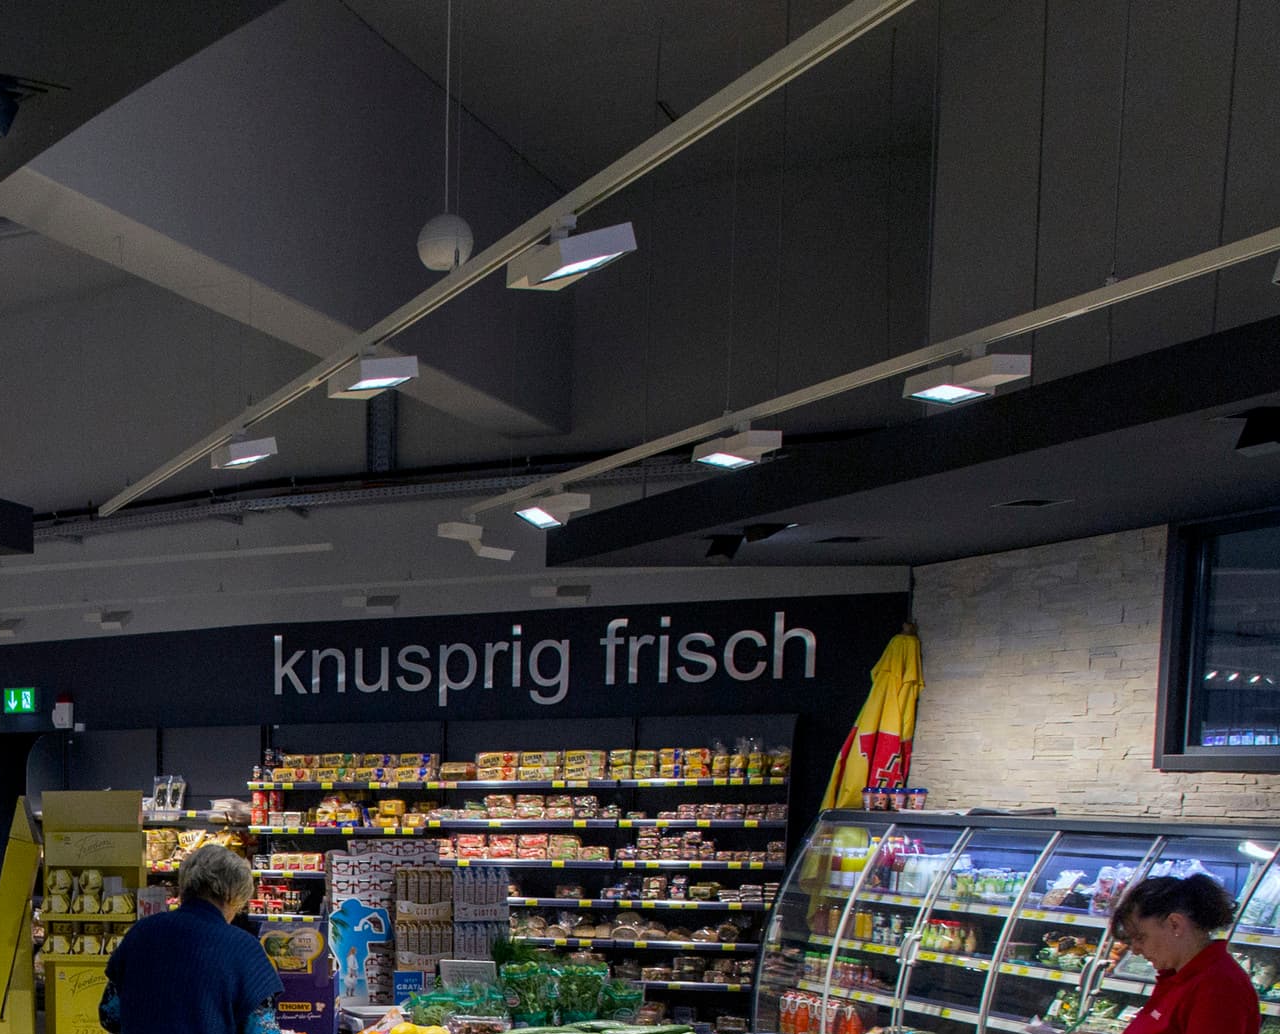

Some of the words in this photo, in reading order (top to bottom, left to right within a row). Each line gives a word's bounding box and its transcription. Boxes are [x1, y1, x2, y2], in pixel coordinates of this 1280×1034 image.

[274, 624, 570, 706] knusprig
[600, 611, 816, 686] frisch
[279, 1003, 311, 1011] THOMY
